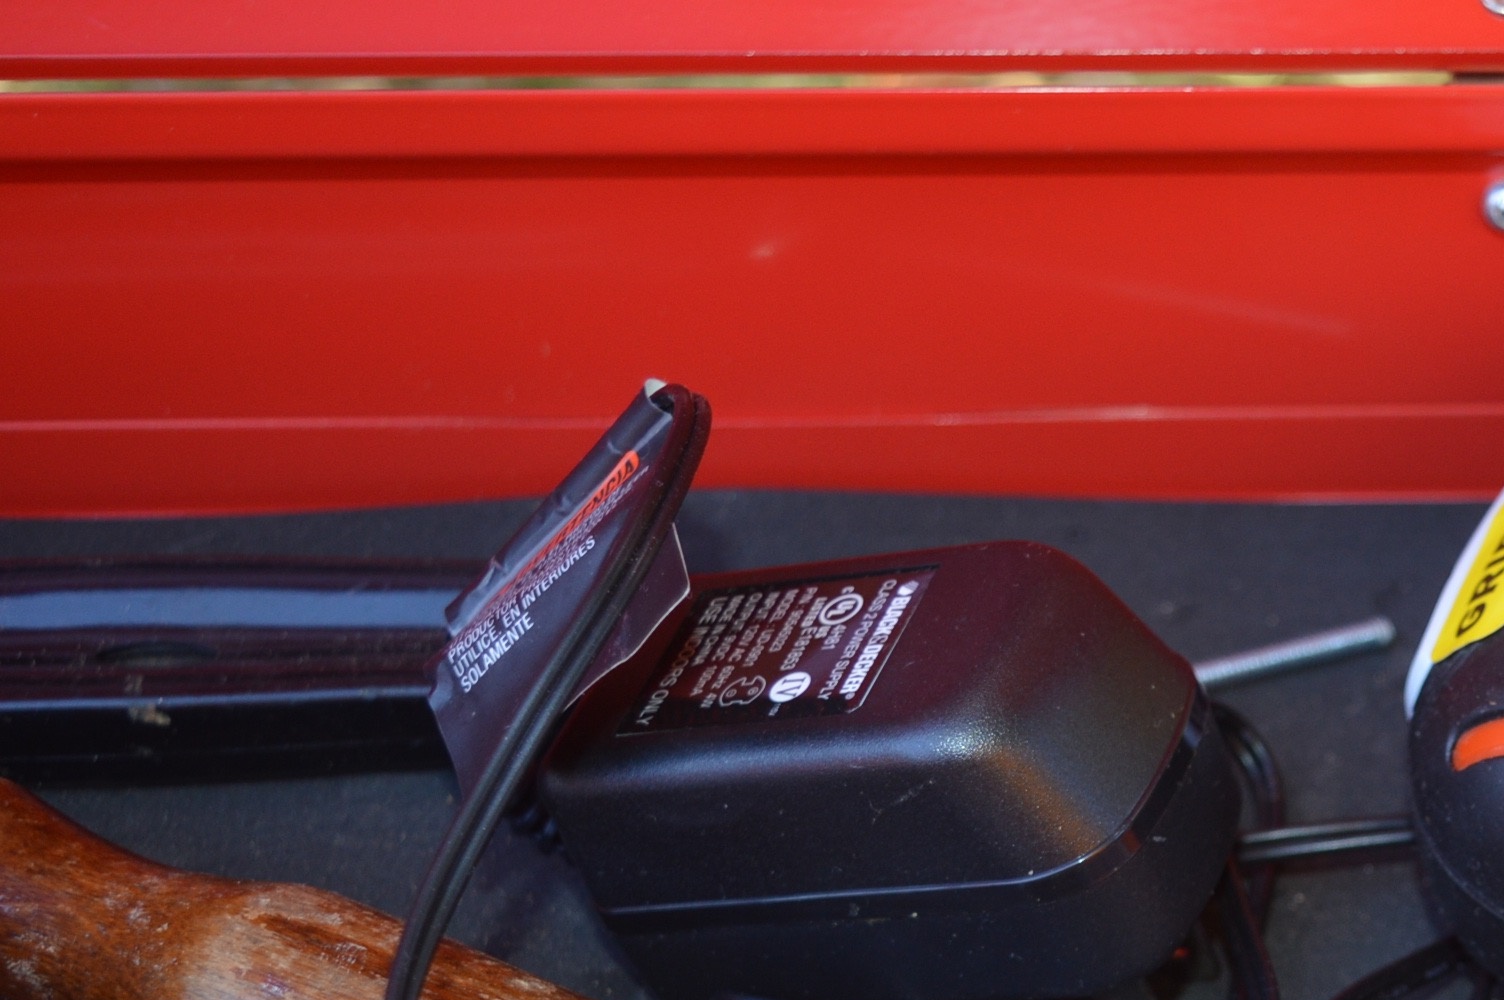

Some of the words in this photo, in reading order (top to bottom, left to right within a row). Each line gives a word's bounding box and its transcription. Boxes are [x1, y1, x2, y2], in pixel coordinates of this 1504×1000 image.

[502, 604, 522, 628] EN
[522, 535, 596, 609] INTERIORES
[868, 580, 895, 611] CLASS
[698, 597, 726, 624] USE
[460, 611, 534, 693] SOLAMENTE
[659, 627, 708, 686] INDOORS
[841, 621, 871, 657] POWER
[817, 660, 848, 699] SUPPLY
[634, 689, 670, 725] ONLY
